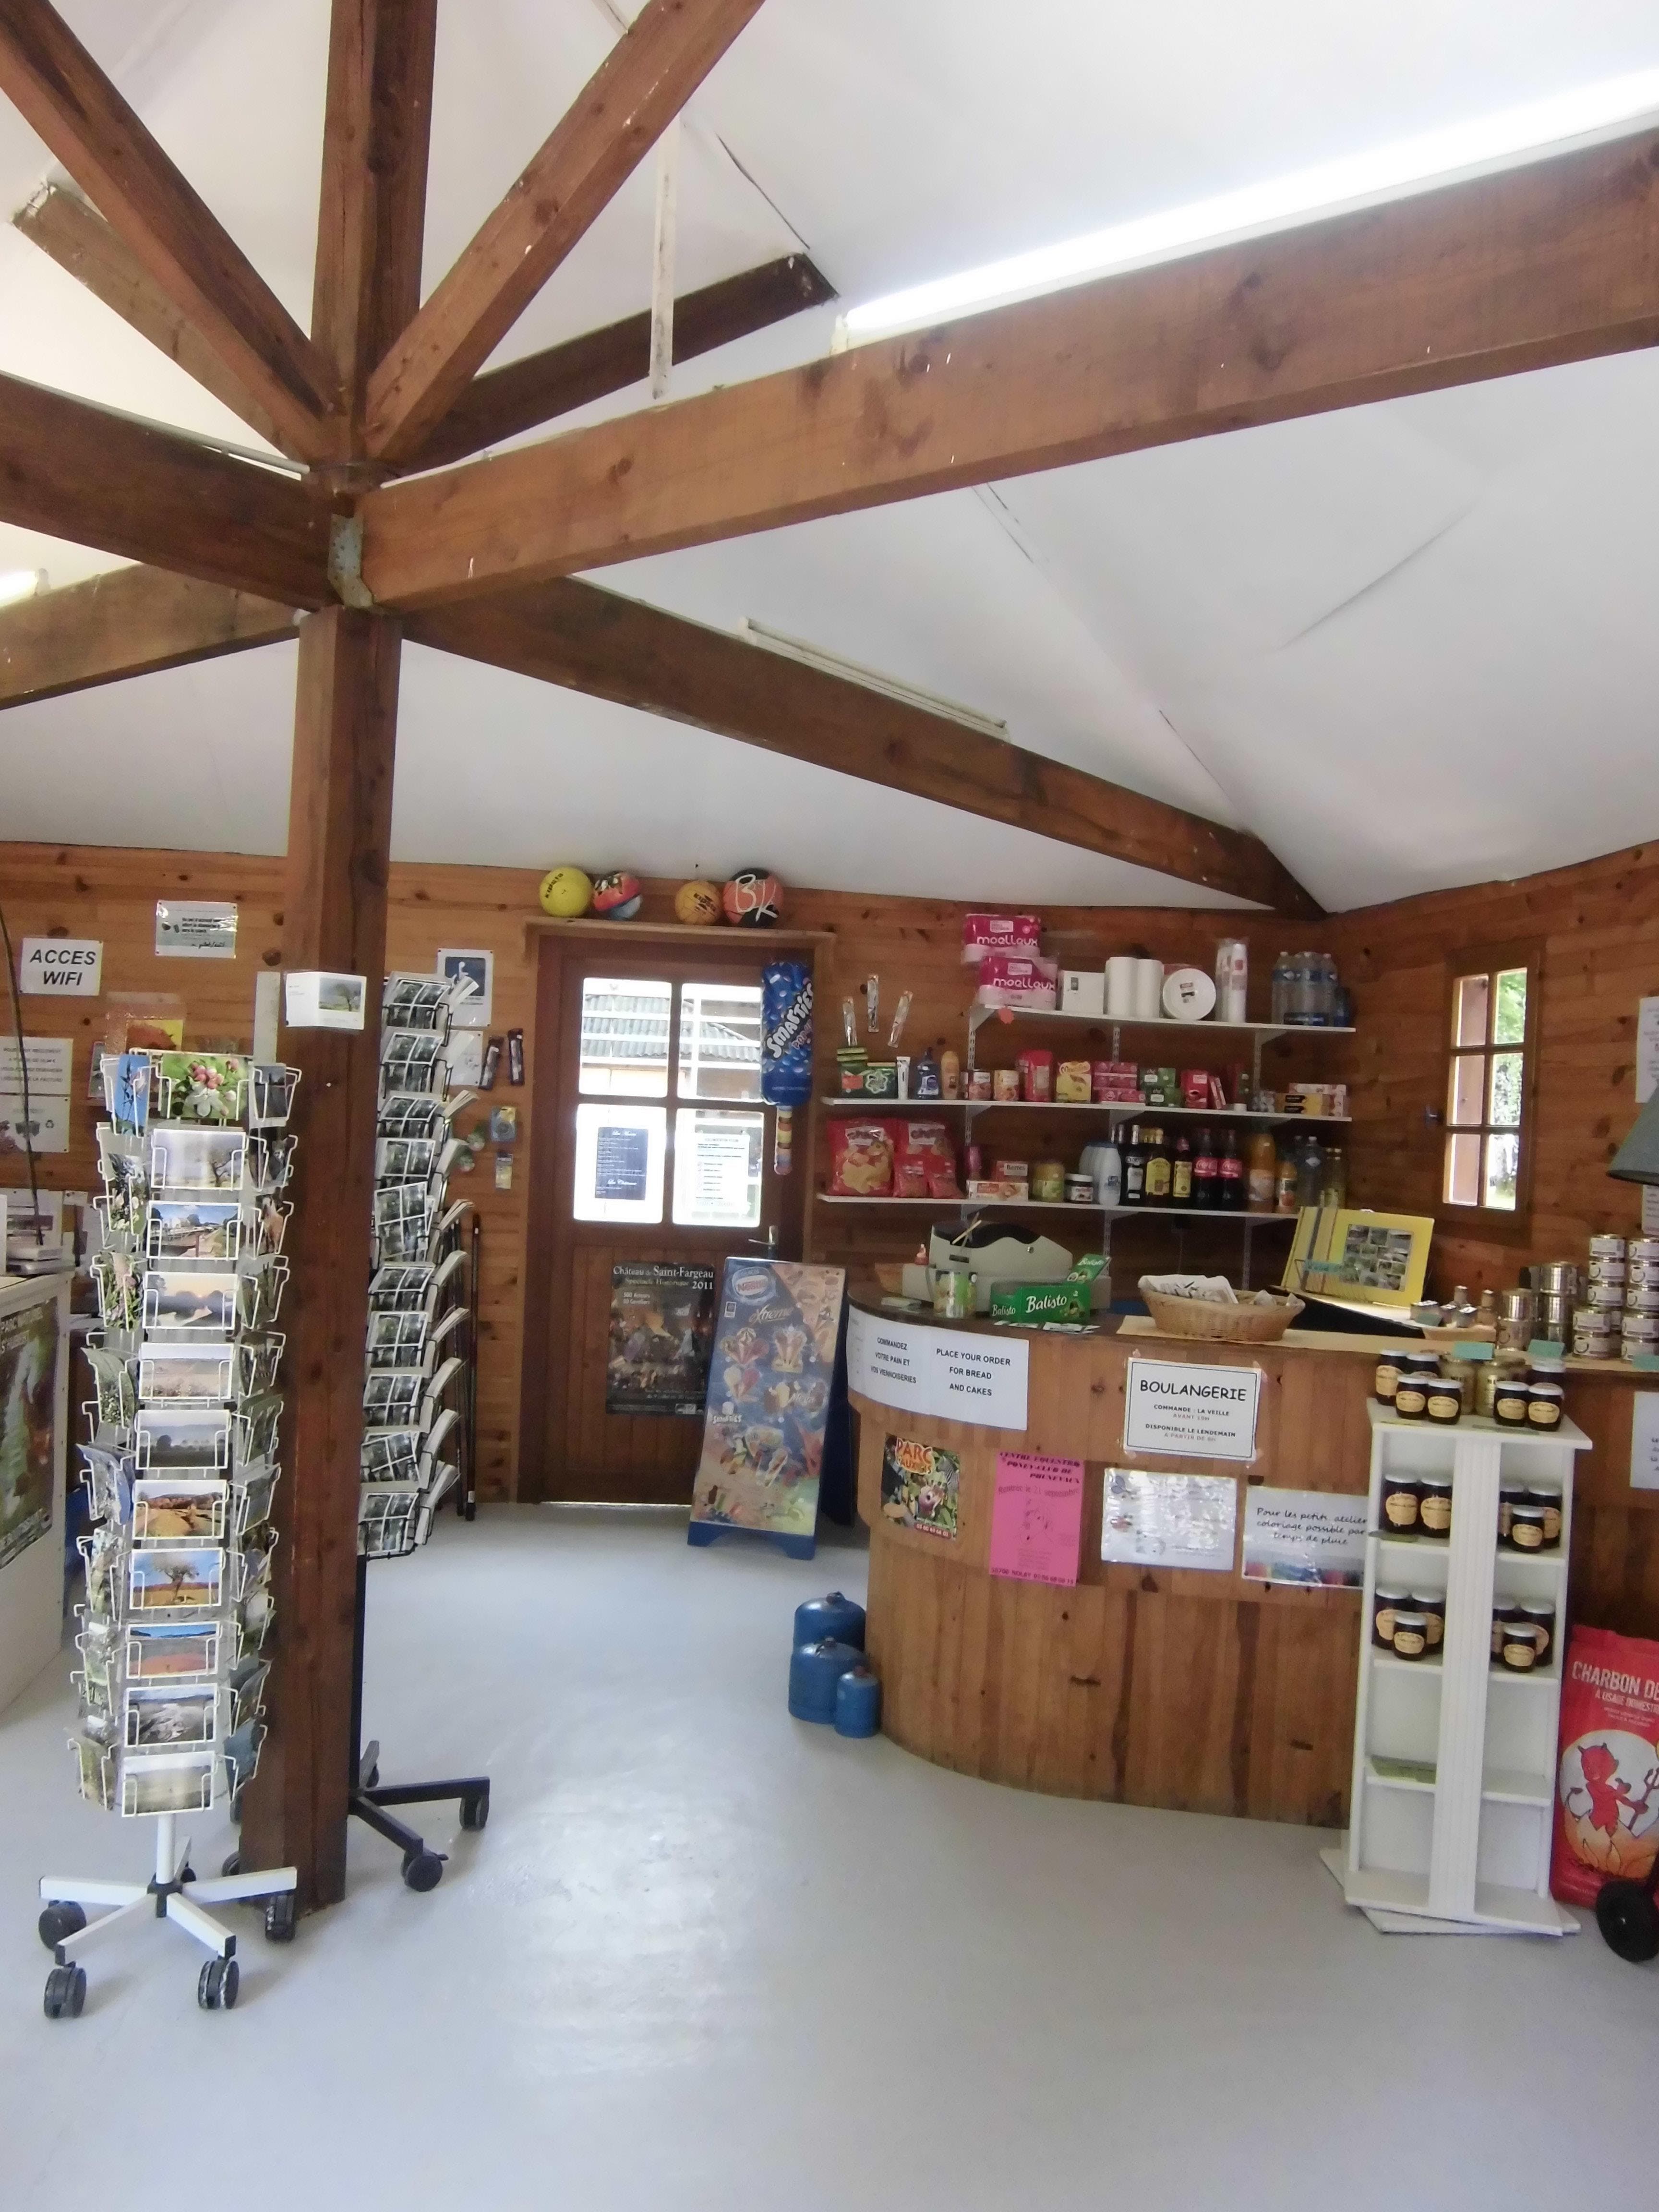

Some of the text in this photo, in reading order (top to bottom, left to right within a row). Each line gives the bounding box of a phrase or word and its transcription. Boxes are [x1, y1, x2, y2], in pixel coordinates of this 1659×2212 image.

[976, 935, 1038, 946] moelleux
[30, 949, 96, 965] ACCES
[44, 971, 83, 986] WIFI
[993, 977, 1055, 990] moelleux
[613, 1265, 644, 1276] Château
[653, 1265, 714, 1279] Saint-Fargeau
[692, 1281, 713, 1290] 2011
[992, 1304, 1016, 1316] Balisto
[1025, 1294, 1067, 1313] Balisto
[877, 1337, 907, 1350] COMMANDEZ
[875, 1352, 889, 1361] VOTRE
[890, 1356, 902, 1364] PAIN
[936, 1348, 1011, 1366] PLACE YOUR ORDER
[879, 1369, 916, 1384] VIENNOISERIES
[949, 1367, 992, 1379] FOR BREAD
[950, 1383, 992, 1396] AND CAKES
[1140, 1380, 1247, 1401] BOULANGERIE
[1154, 1404, 1191, 1413] COMMANDE
[1145, 1424, 1185, 1432] DISPONIBLE
[1197, 1429, 1236, 1437] LENDEMAIN
[897, 1438, 933, 1464] PARC
[1257, 1507, 1280, 1516] Pour
[1257, 1520, 1302, 1530] coloriage
[1306, 1525, 1344, 1534] possible
[1572, 1661, 1641, 1696] CHARBON
